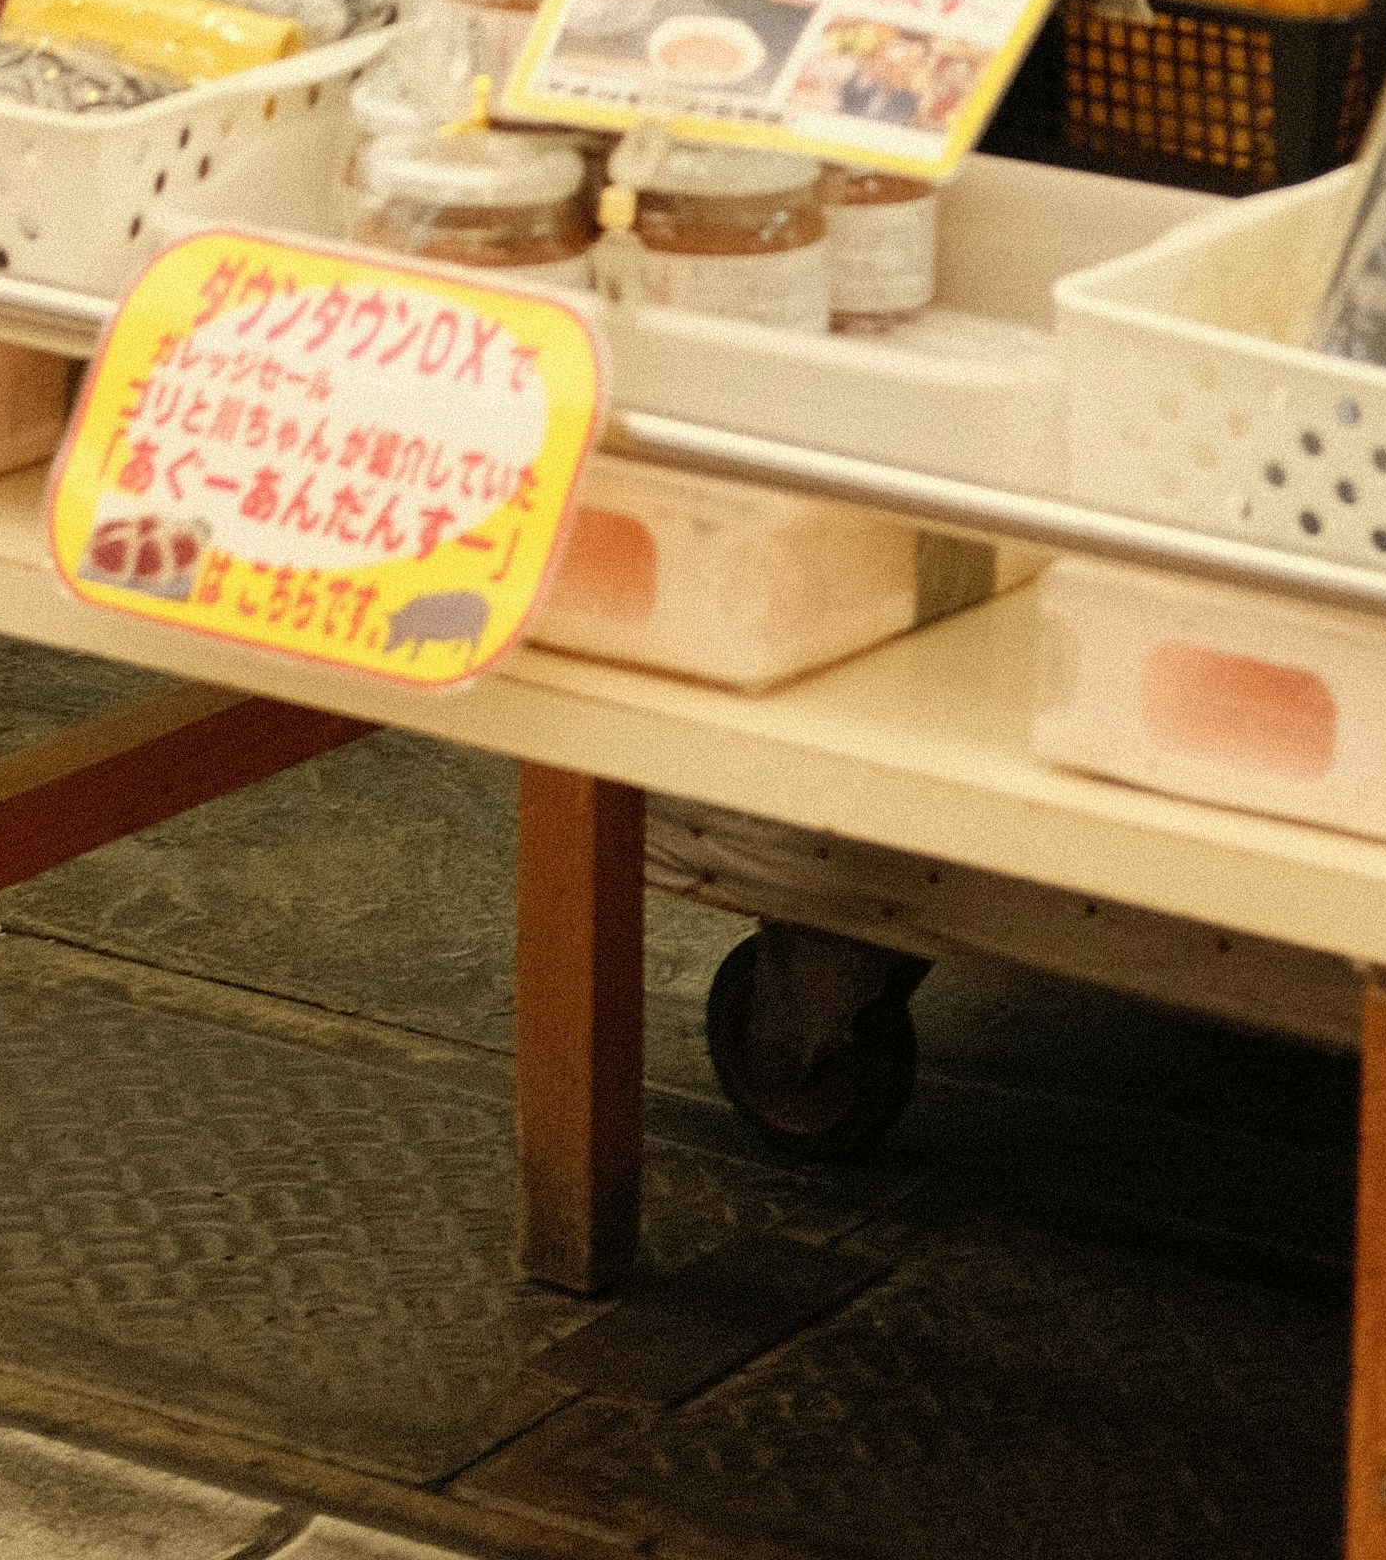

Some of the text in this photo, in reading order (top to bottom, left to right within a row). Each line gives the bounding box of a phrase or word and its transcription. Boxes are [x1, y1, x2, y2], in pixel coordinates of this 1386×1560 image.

[150, 331, 335, 402] ガレッジセール
[190, 254, 540, 394] ダウンタウンDXで
